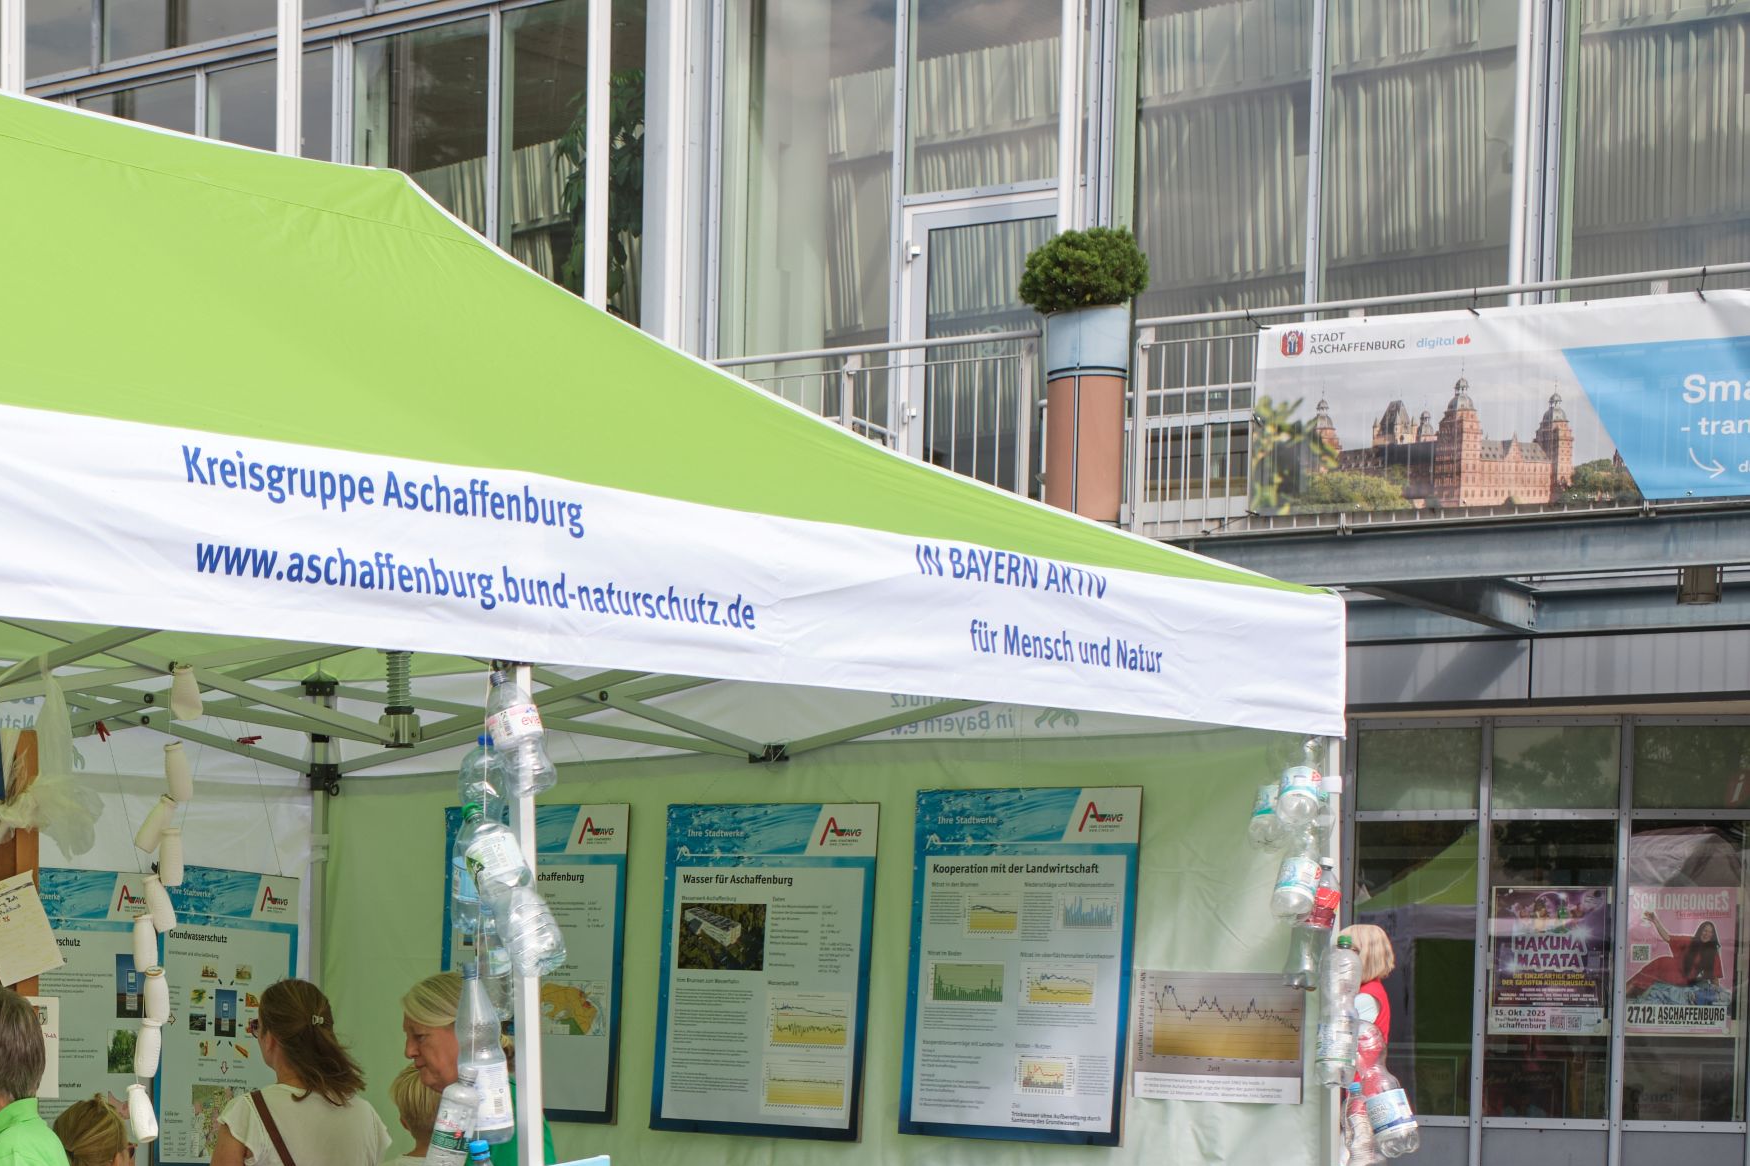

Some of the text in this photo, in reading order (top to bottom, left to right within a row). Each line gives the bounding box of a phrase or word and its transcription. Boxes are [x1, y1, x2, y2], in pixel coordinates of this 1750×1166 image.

[1310, 332, 1345, 343] STADT
[1416, 336, 1455, 349] digital
[1310, 340, 1405, 354] ASCHAFFENBURG
[182, 445, 585, 538] Kreisgruppe Aschaffenburg
[916, 544, 1107, 599] IN BAYERN AKTIV
[196, 541, 756, 630] www.aschaffenburg.bund-naturschutz.de
[970, 619, 1162, 674] für Mensch und Natur
[938, 816, 997, 824] Ihre Stadtwerke
[1106, 814, 1123, 822] AVG
[688, 829, 702, 837] Ihre
[933, 863, 1098, 876] Kooperation mit der Landwirtschaft
[683, 874, 793, 886] Wasser für Aschaffenburg
[183, 888, 210, 897] Stadtwerke
[276, 898, 288, 906] AVG
[169, 929, 228, 944] Grundwasserschutz
[1514, 936, 1584, 953] HAKUNA
[1517, 953, 1581, 969] MATATA
[1658, 1007, 1725, 1021] ASCHAFFENBURG
